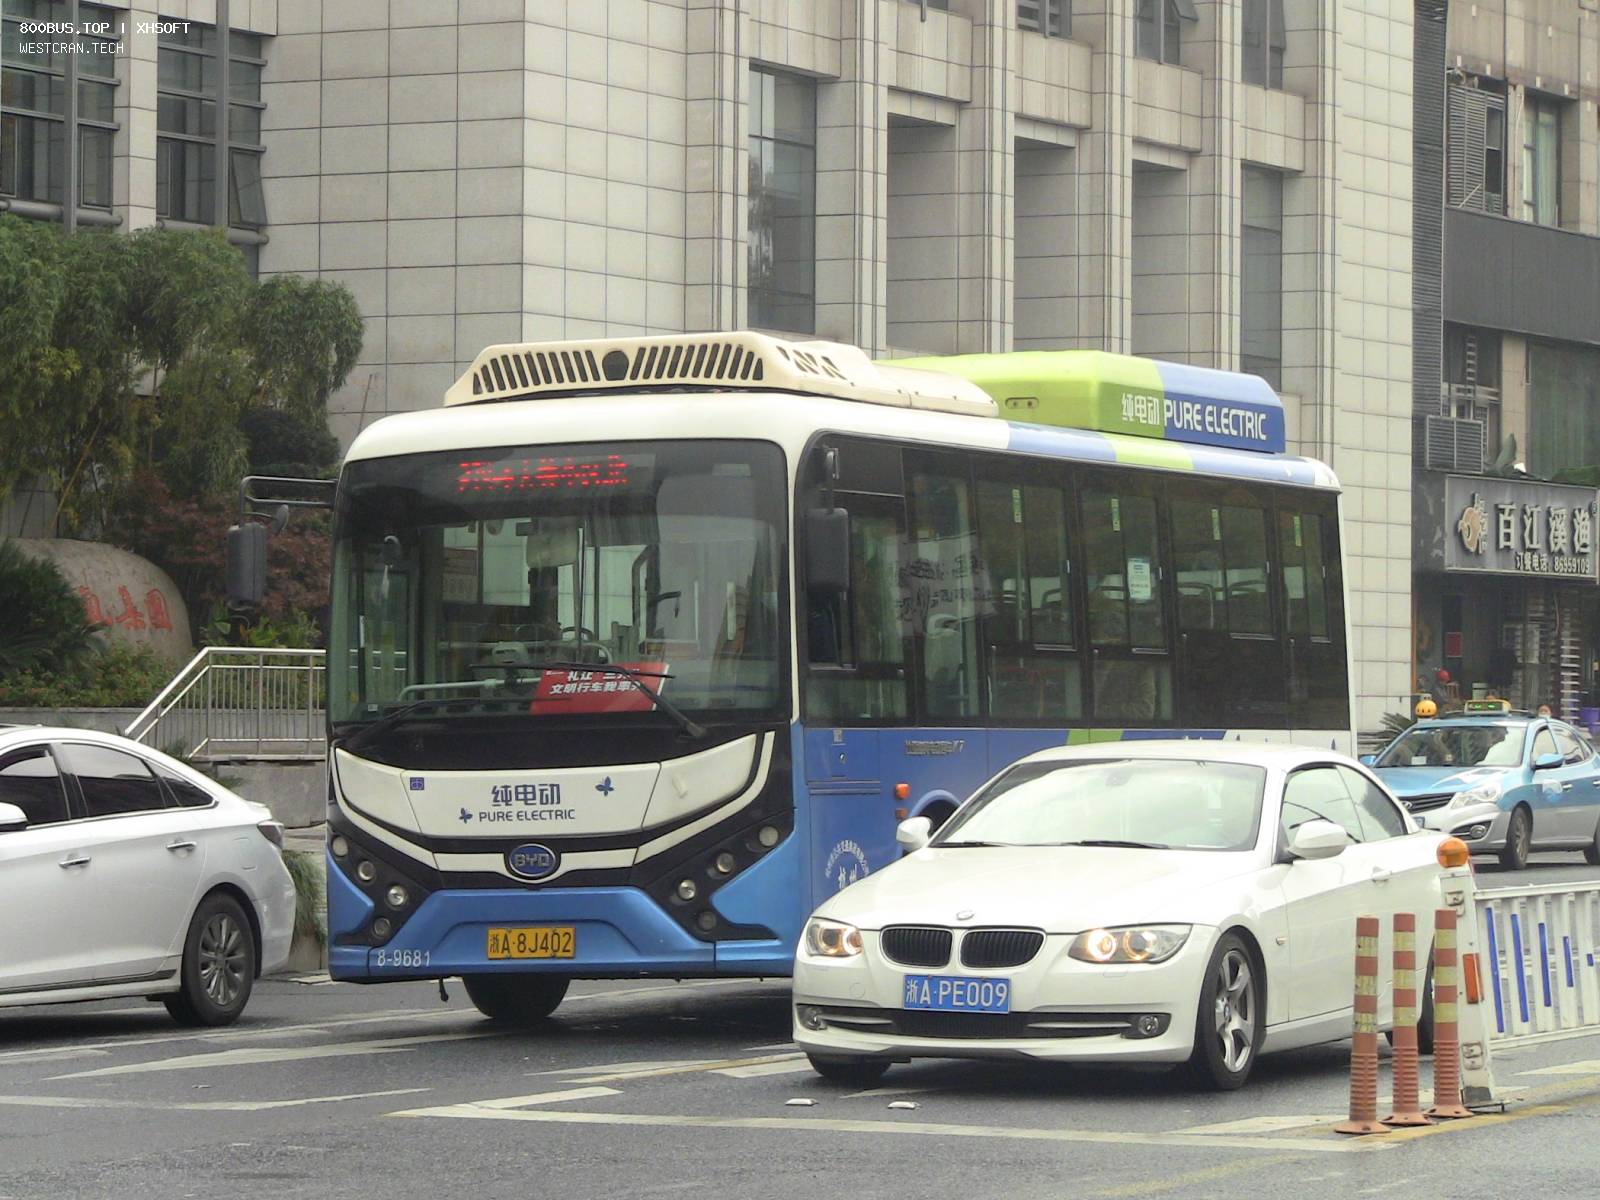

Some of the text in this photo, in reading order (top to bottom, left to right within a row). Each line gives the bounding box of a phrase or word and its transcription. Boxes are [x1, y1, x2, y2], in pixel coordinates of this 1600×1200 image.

[1121, 392, 1160, 425] 纯电动
[1163, 399, 1267, 441] PURE ELECTRIC
[491, 783, 561, 807] 纯电动
[479, 808, 576, 822] PURE ELECTRIC
[514, 852, 550, 867] BYD
[377, 949, 432, 968] 8-9681
